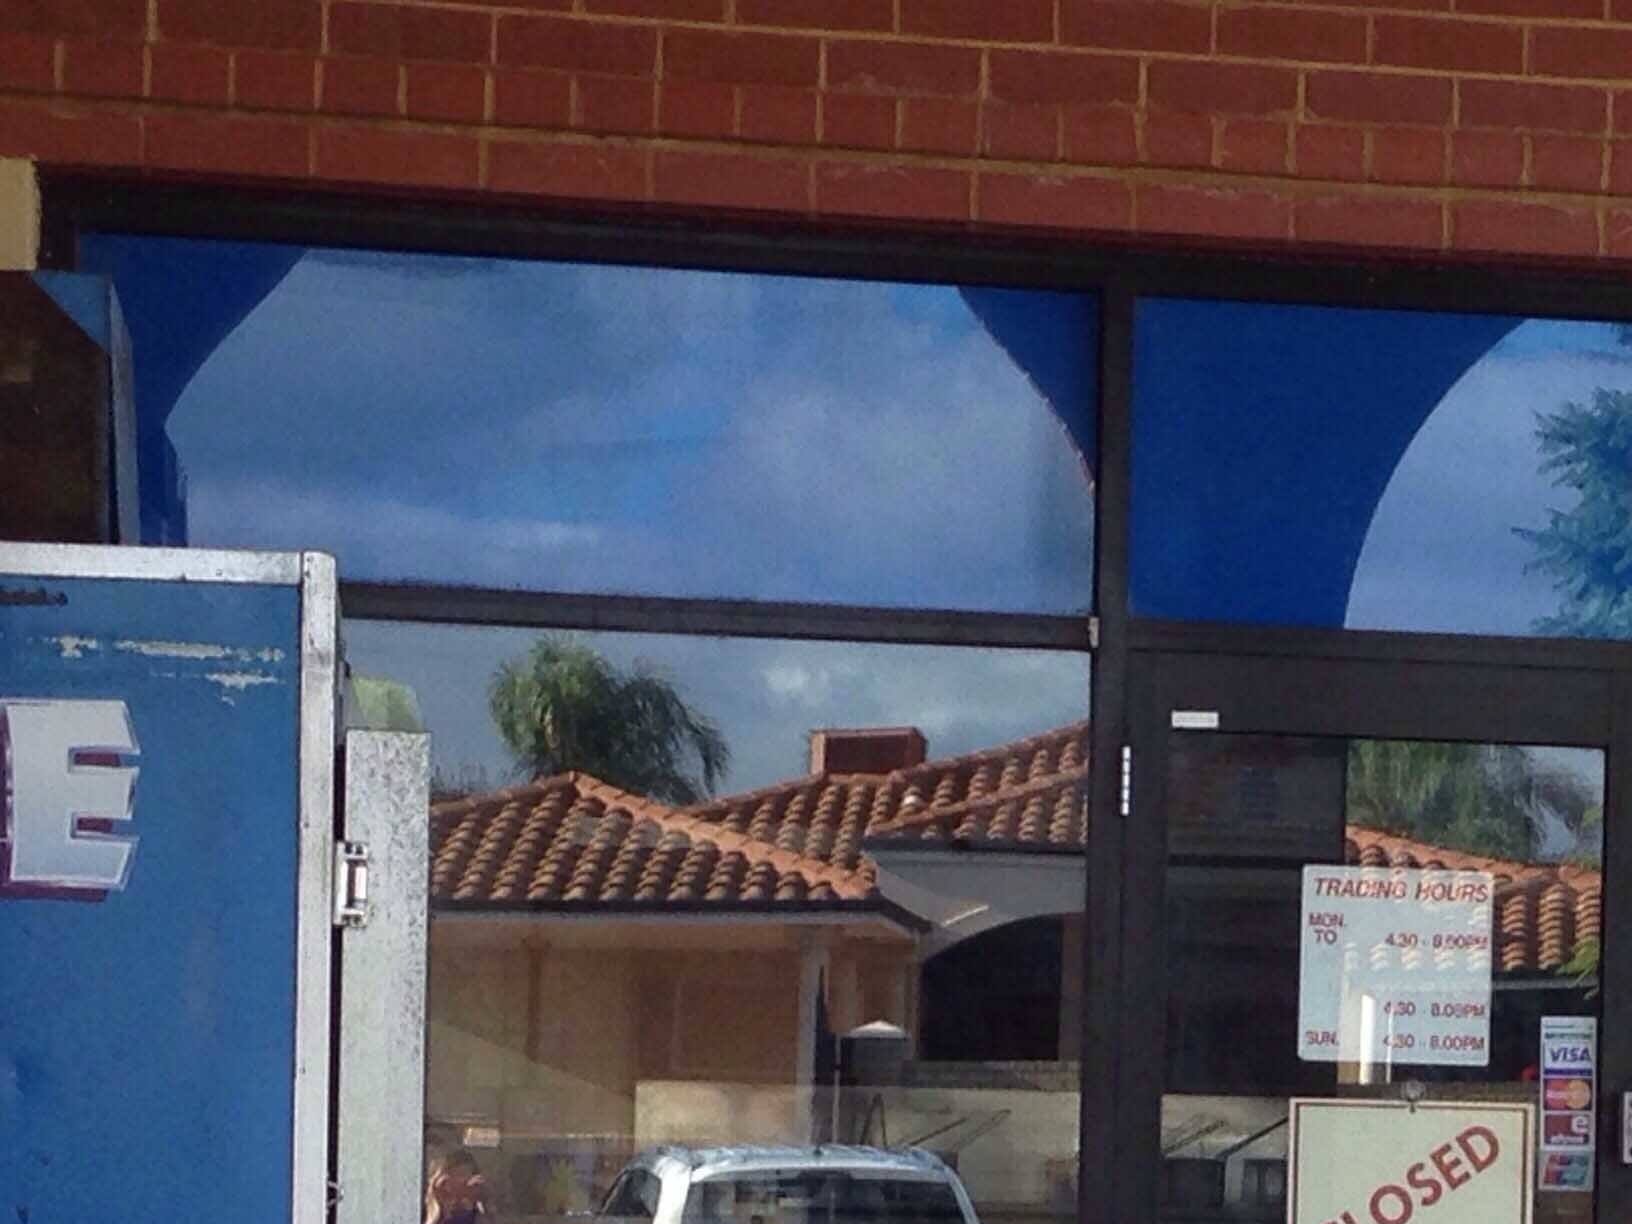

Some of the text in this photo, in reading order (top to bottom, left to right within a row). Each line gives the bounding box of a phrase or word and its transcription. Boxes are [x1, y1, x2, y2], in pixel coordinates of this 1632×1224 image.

[1314, 876, 1489, 904] TRADING HOURS
[1314, 930, 1338, 945] TO
[1551, 1047, 1592, 1063] VISA
